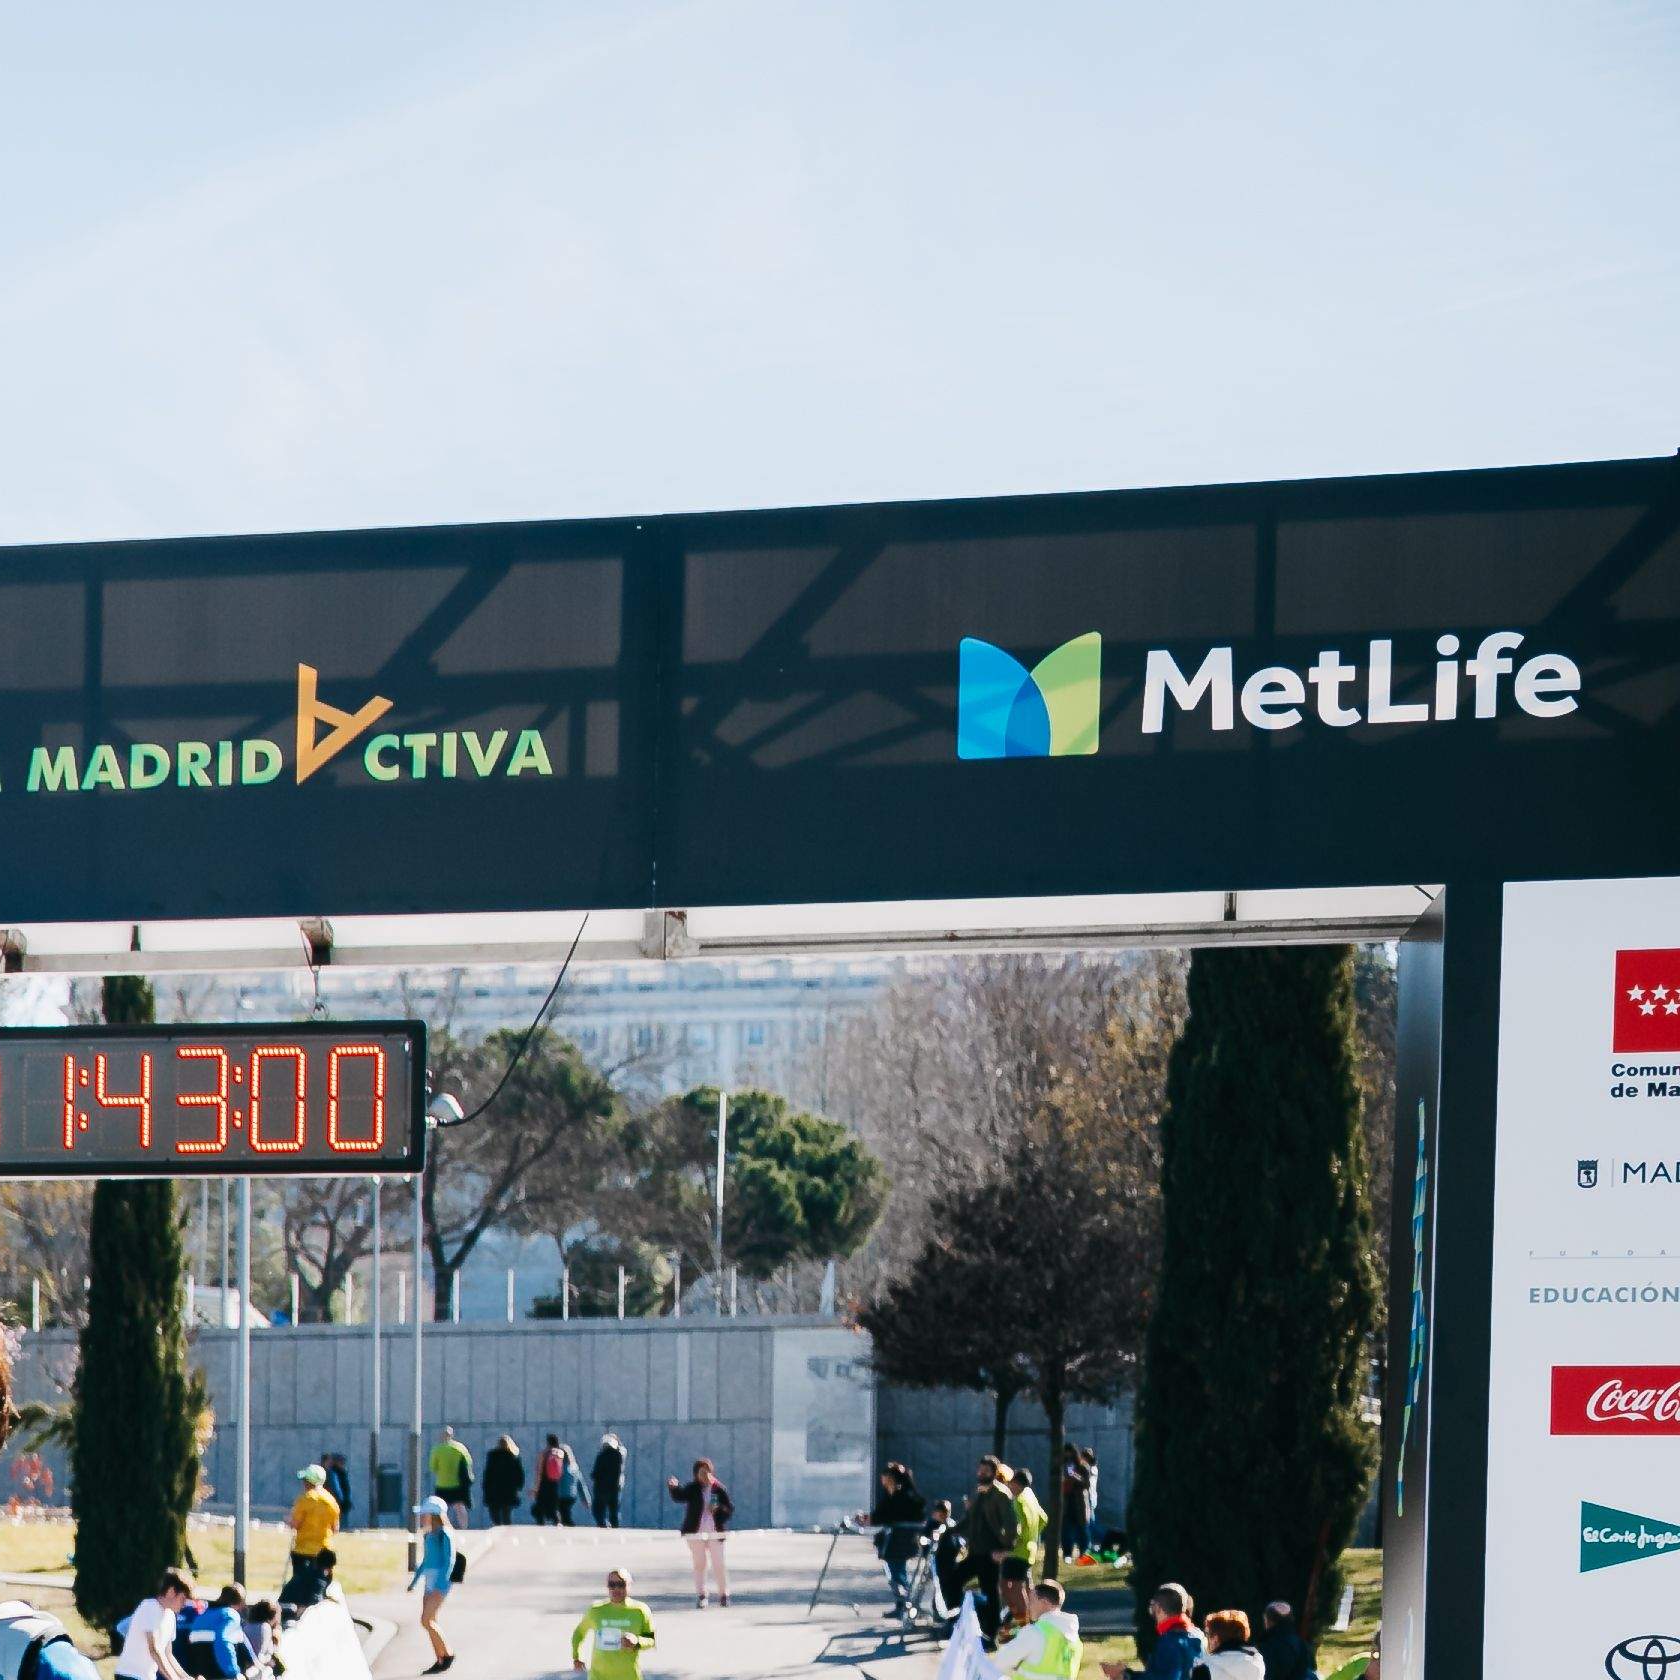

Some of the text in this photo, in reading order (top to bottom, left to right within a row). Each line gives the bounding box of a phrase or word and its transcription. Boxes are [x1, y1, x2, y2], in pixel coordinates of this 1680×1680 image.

[1141, 631, 1582, 734] MetLife
[25, 738, 283, 792] MADRID
[297, 663, 554, 786] ACTIVA
[1610, 1083, 1639, 1098] de
[1623, 1161, 1680, 1184] MA
